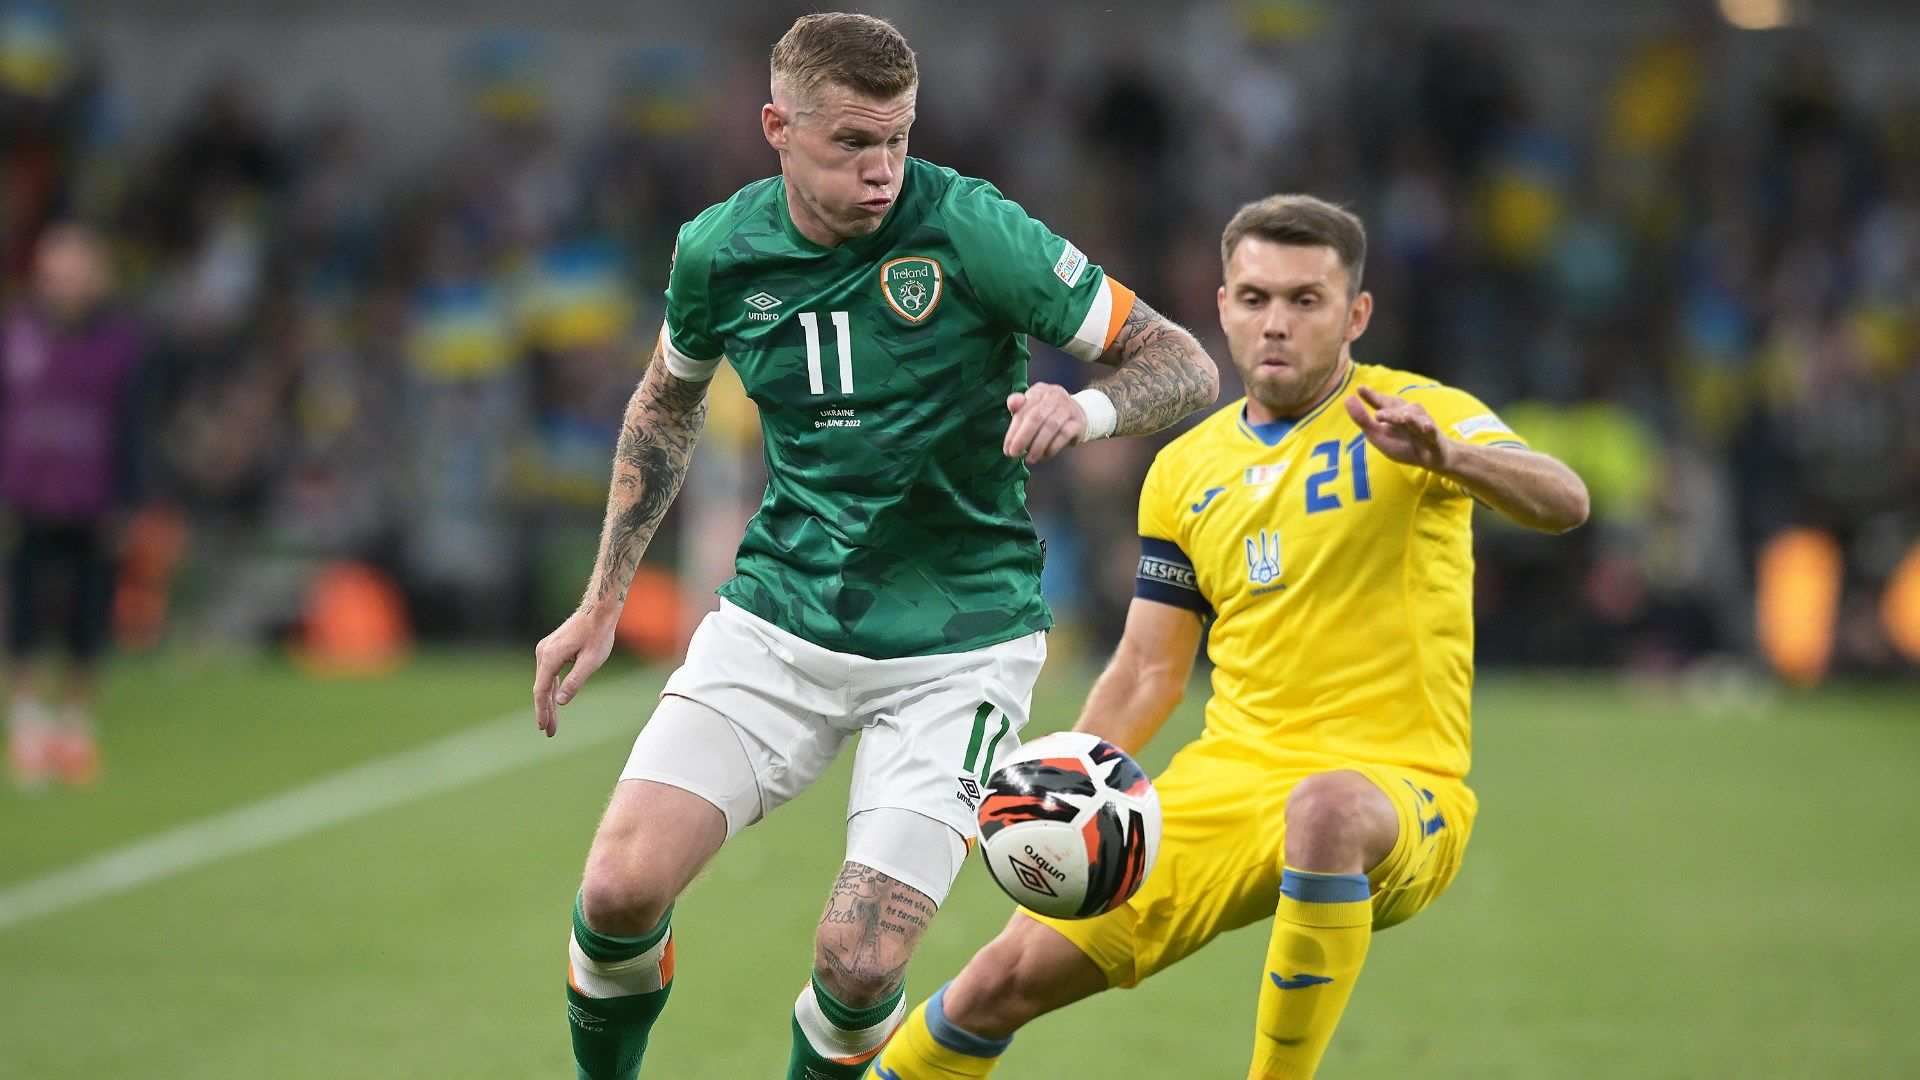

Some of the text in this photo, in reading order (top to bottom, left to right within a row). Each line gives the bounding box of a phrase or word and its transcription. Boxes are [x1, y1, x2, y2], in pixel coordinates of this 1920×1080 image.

[891, 266, 928, 280] Ireland
[748, 312, 780, 321] umbro
[798, 311, 854, 395] 11
[820, 409, 855, 417] UKRAINE
[826, 419, 844, 429] JUNE
[844, 419, 861, 428] 2022
[1305, 431, 1372, 515] 21
[1142, 559, 1198, 587] RESPEC
[963, 700, 1010, 789] 11
[956, 791, 976, 812] umbro
[1024, 844, 1066, 882] umbro
